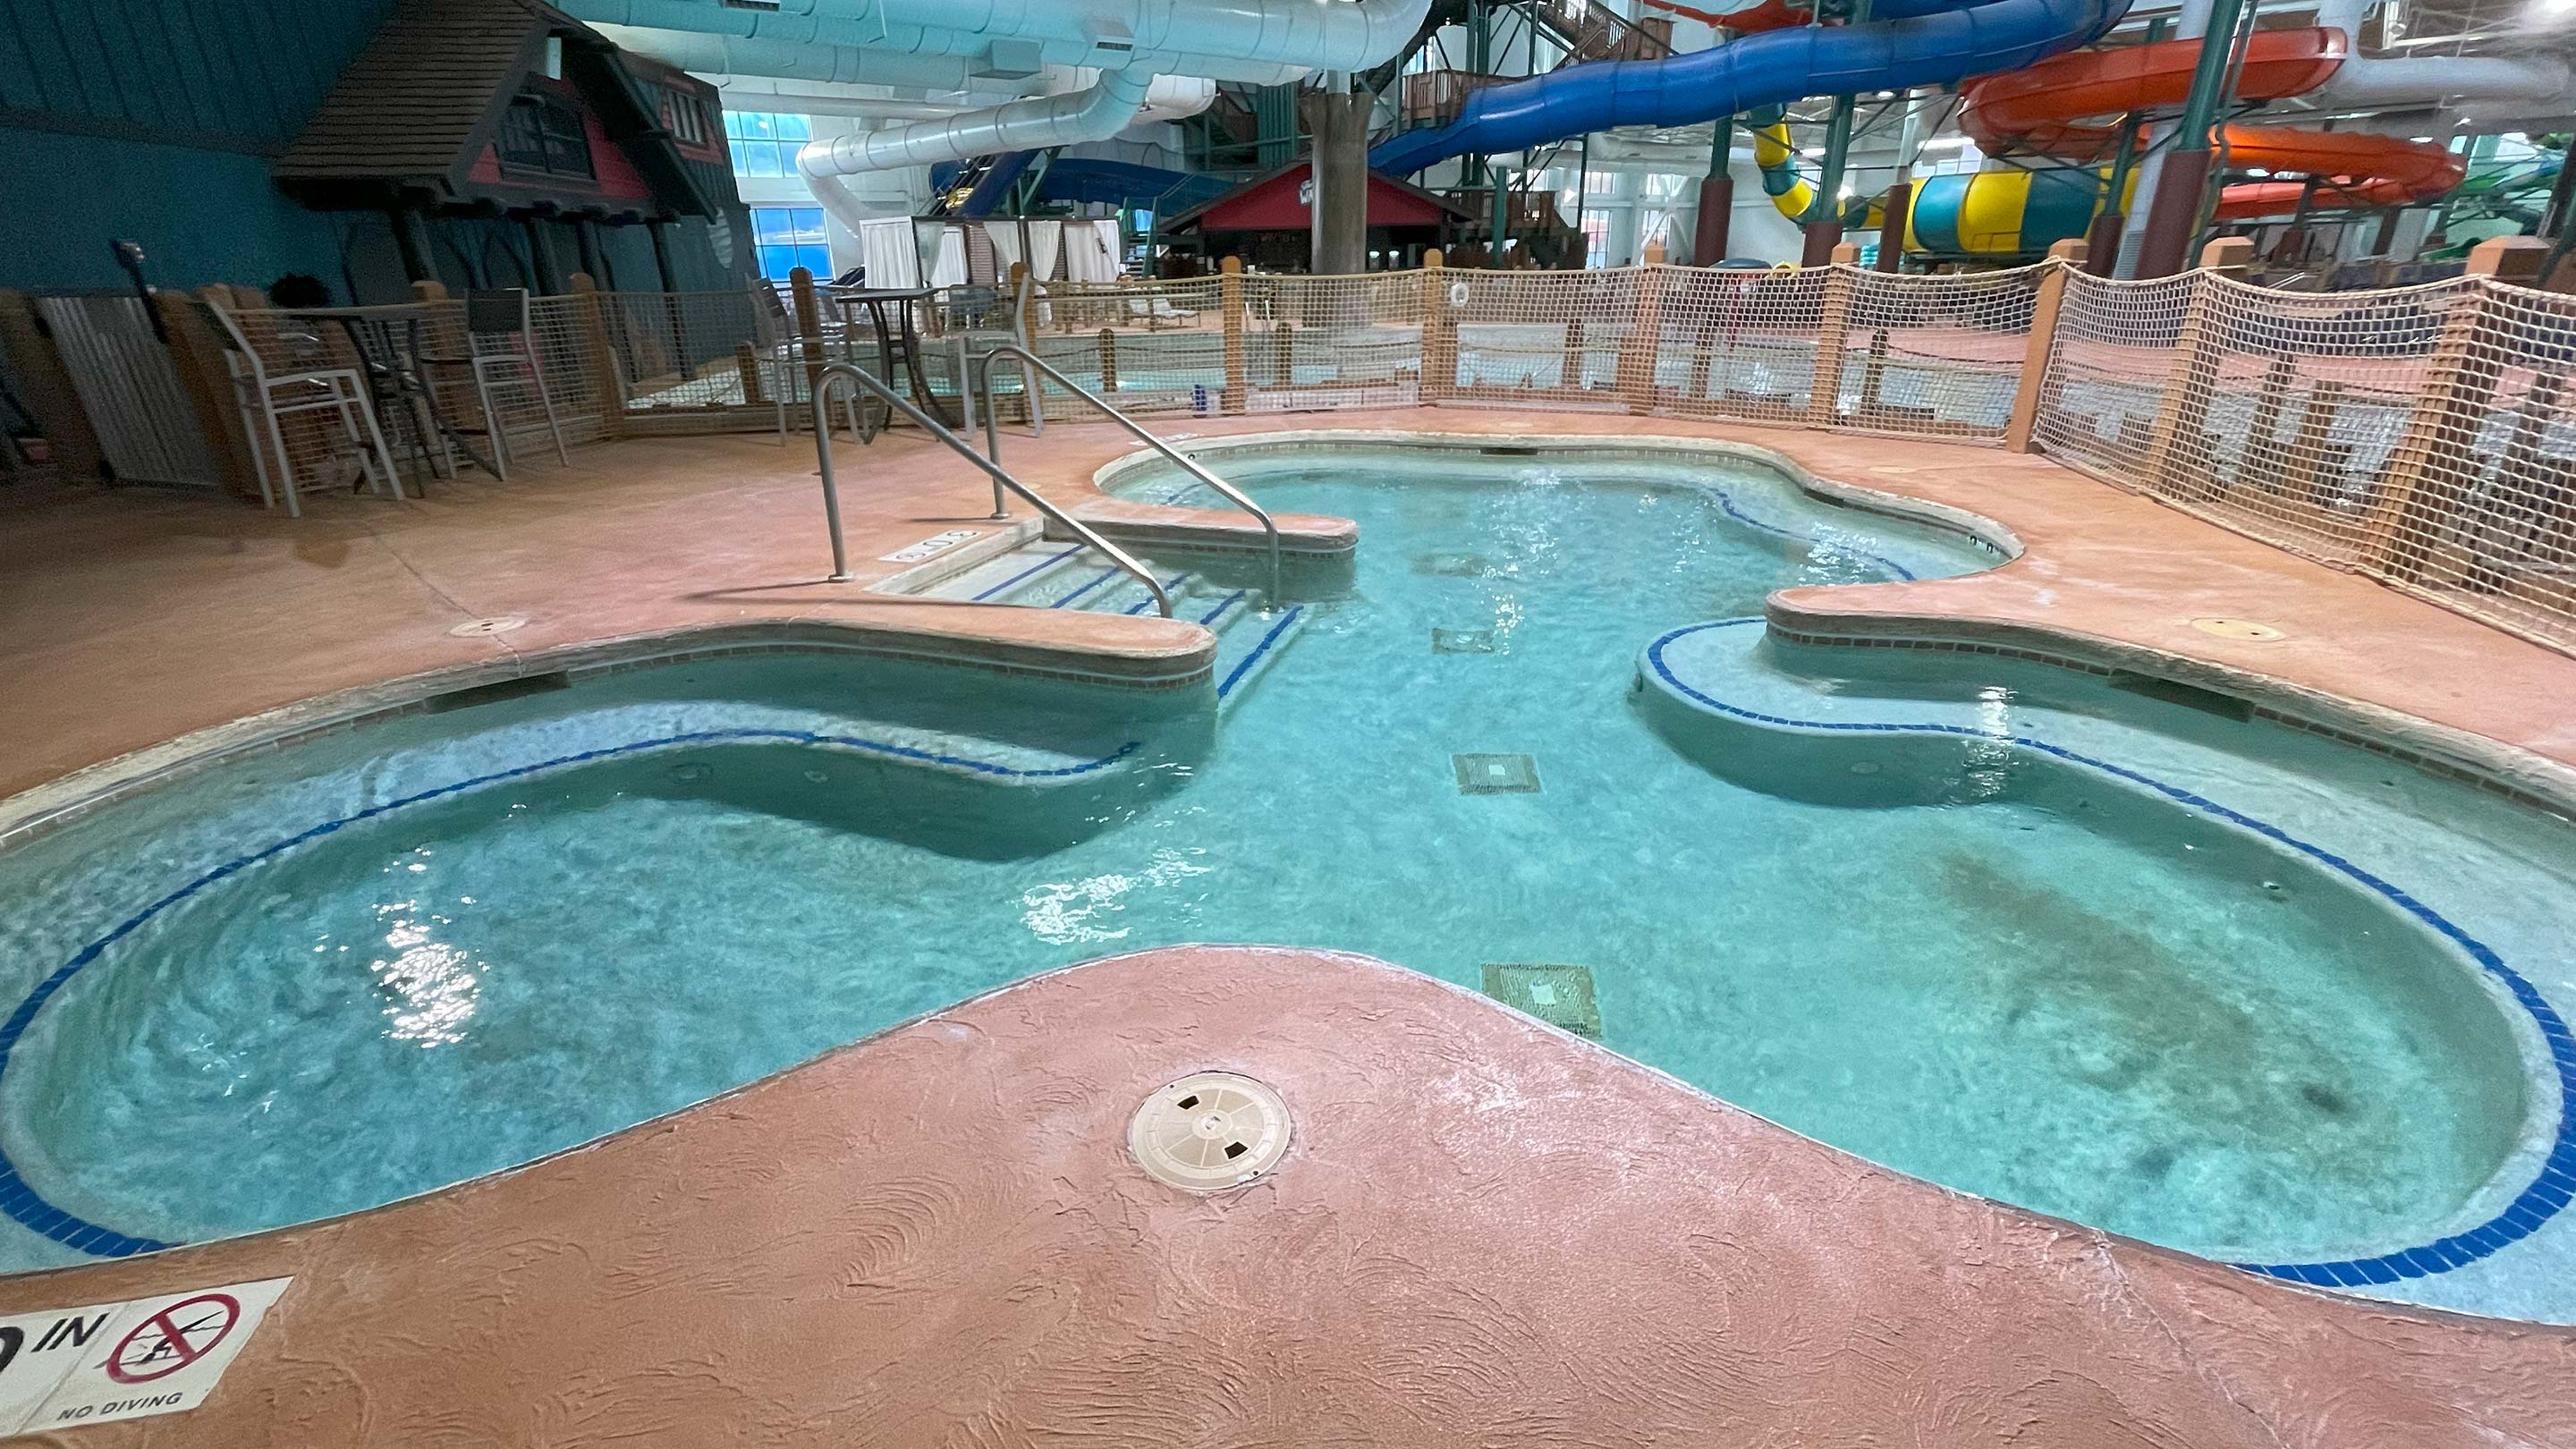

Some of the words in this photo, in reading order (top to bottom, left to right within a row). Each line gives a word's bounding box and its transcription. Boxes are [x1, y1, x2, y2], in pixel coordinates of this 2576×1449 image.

[30, 1312, 111, 1352] IN
[56, 1405, 93, 1420] NO
[99, 1392, 183, 1416] DIVING
